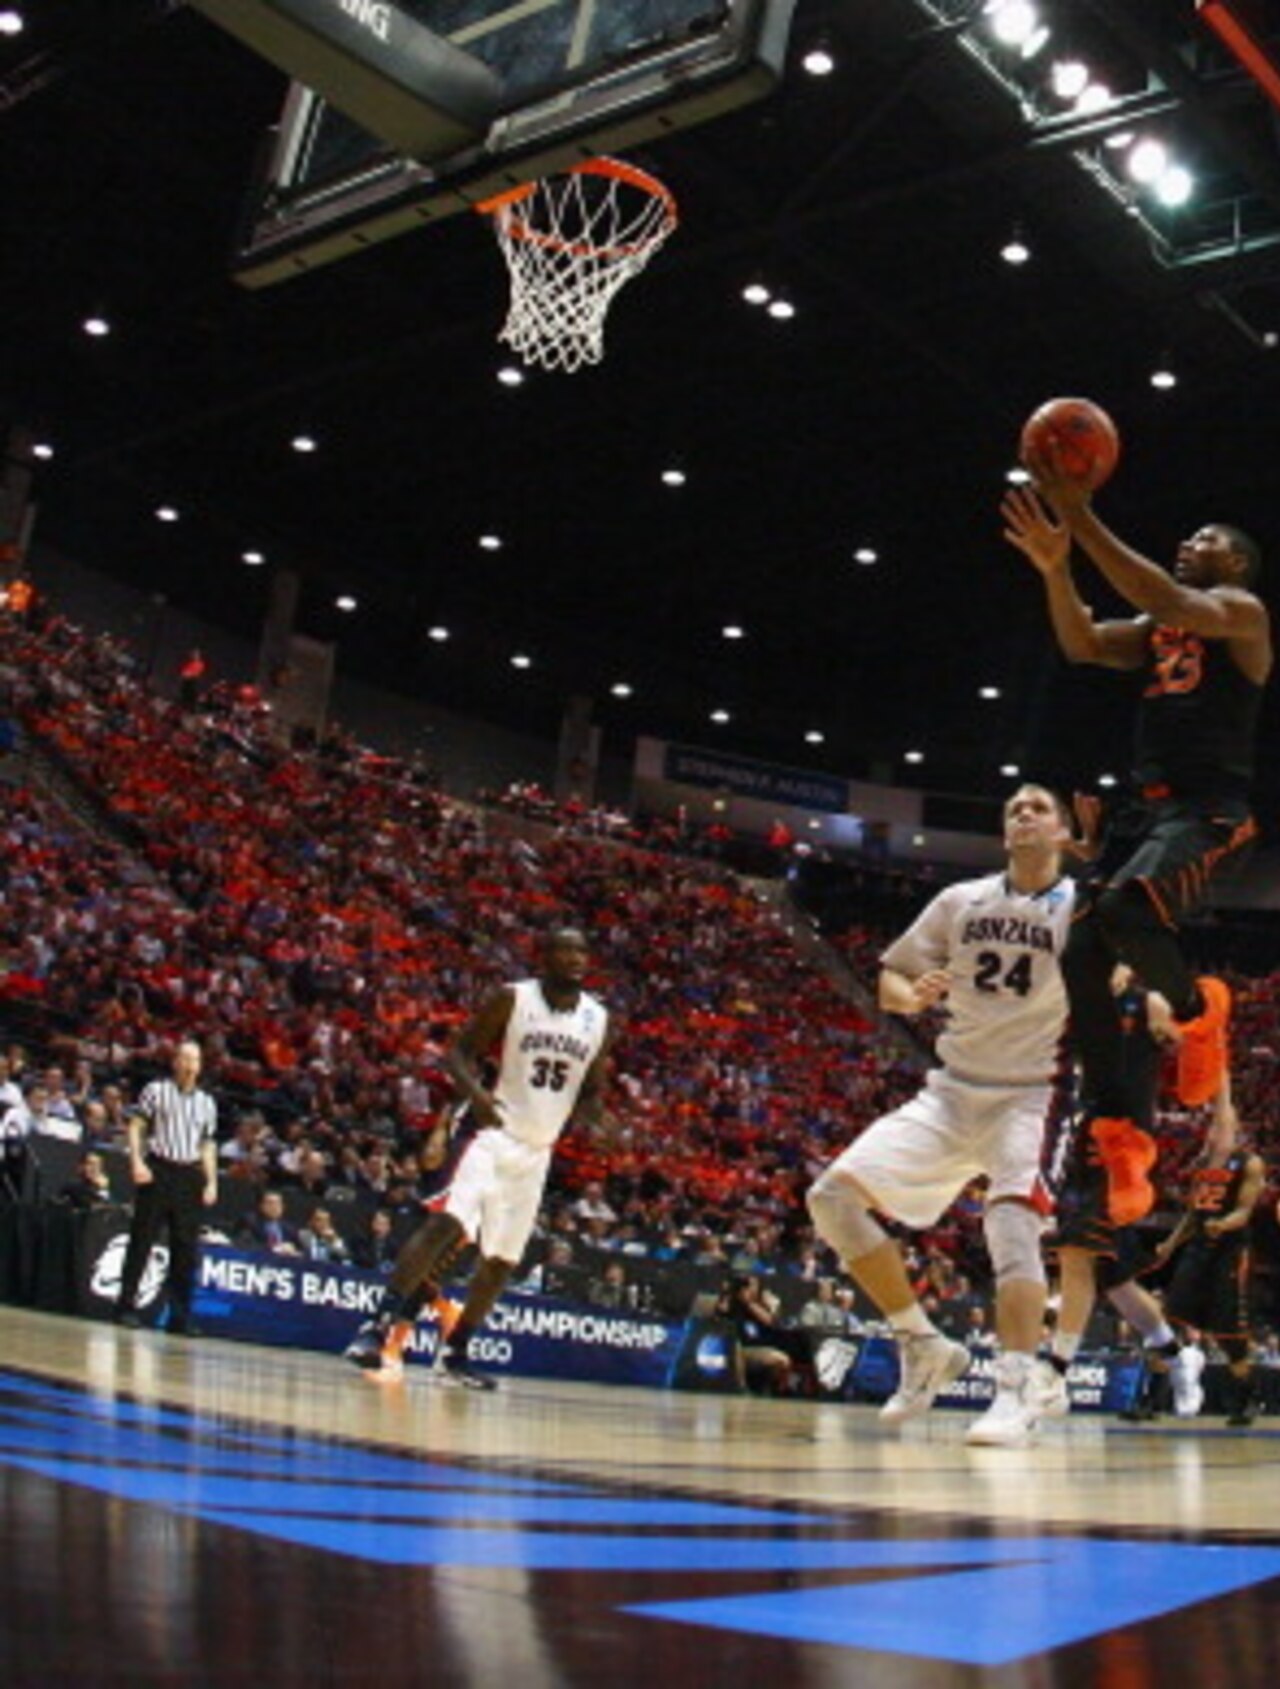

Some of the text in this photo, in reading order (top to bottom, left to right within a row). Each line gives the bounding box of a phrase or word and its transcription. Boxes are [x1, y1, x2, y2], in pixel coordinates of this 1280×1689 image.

[960, 916, 1054, 954] GONZAGA
[974, 950, 1031, 996] 24
[530, 1057, 569, 1092] 35
[201, 1257, 293, 1301] MEN'S
[486, 1303, 667, 1350] CHAMPIONSHIP
